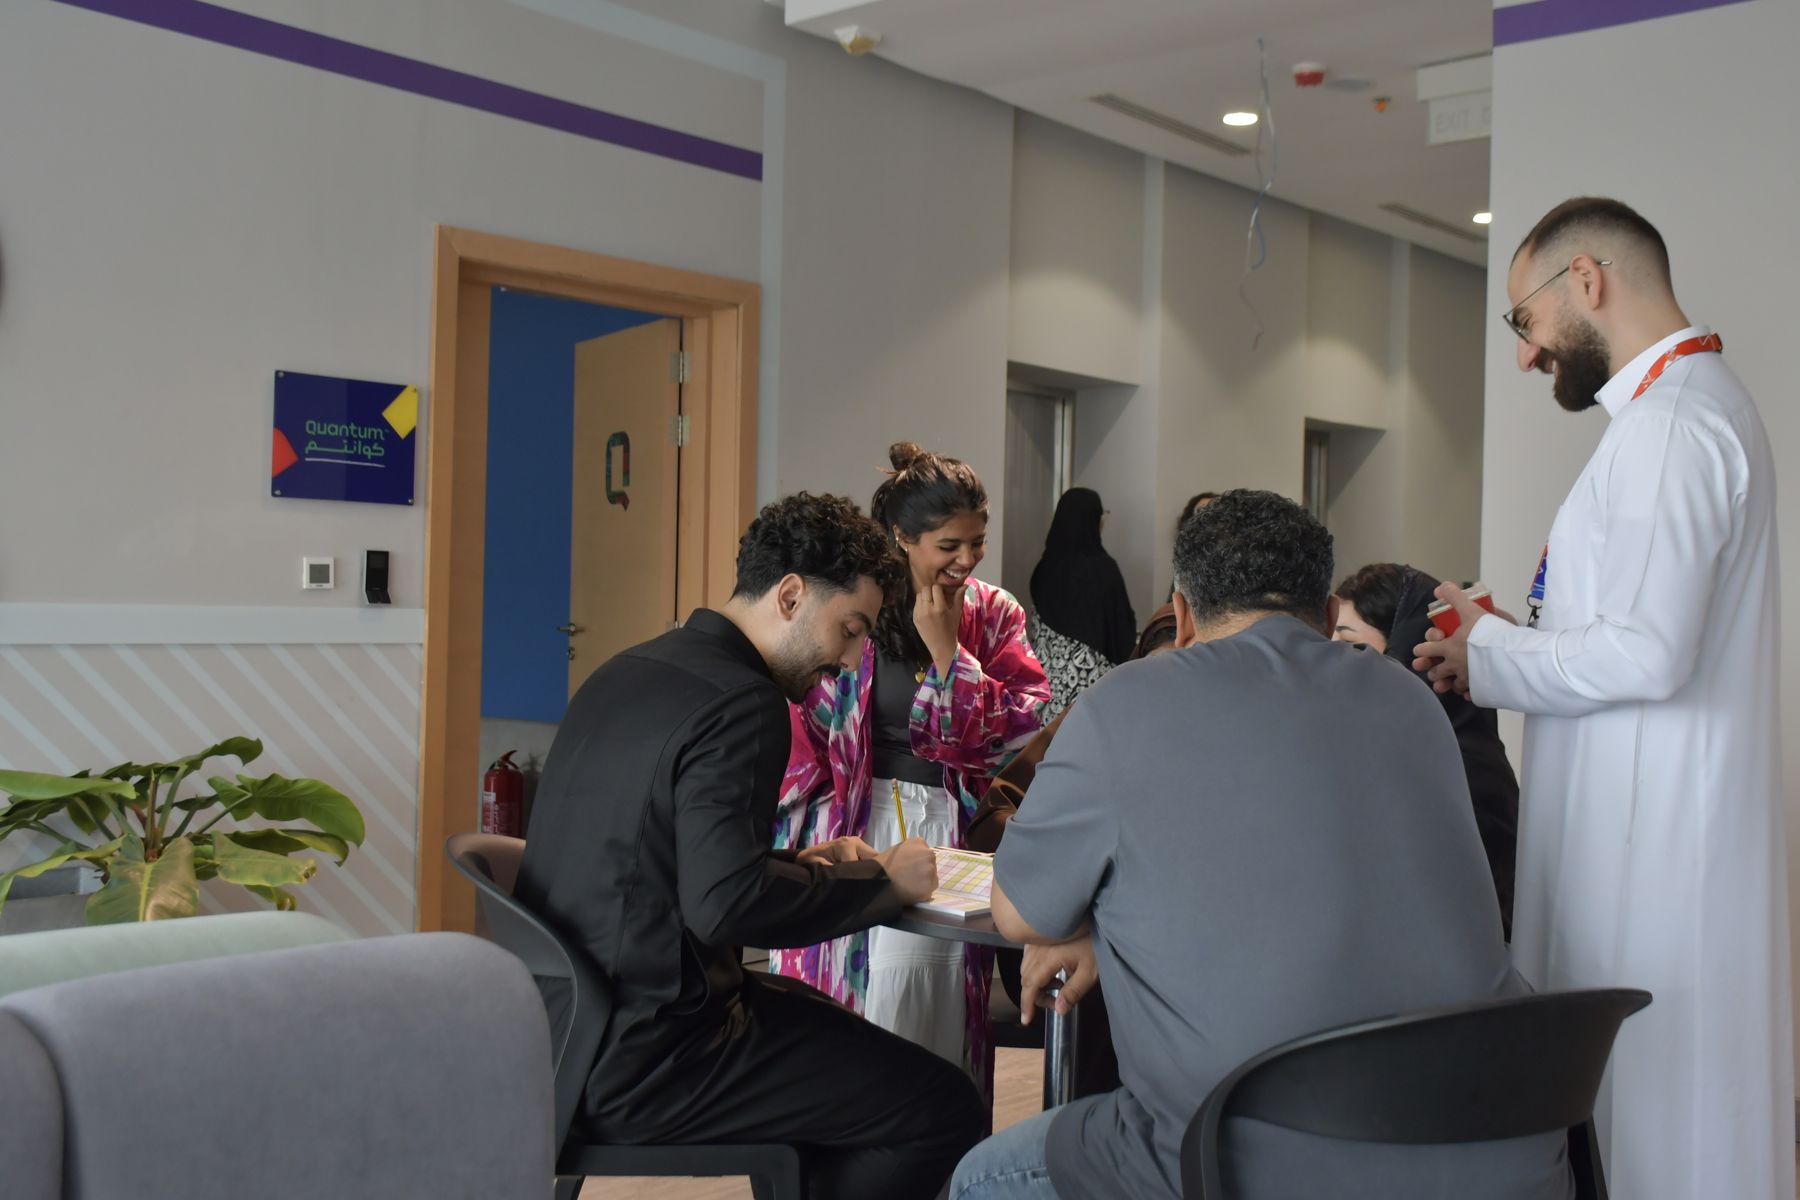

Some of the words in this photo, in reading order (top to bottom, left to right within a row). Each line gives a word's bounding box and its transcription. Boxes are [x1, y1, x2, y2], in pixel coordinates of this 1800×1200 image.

[1435, 109, 1471, 134] EXIT
[305, 419, 385, 440] Quantum
[305, 439, 385, 460] كوانتم
[605, 430, 630, 512] Q
